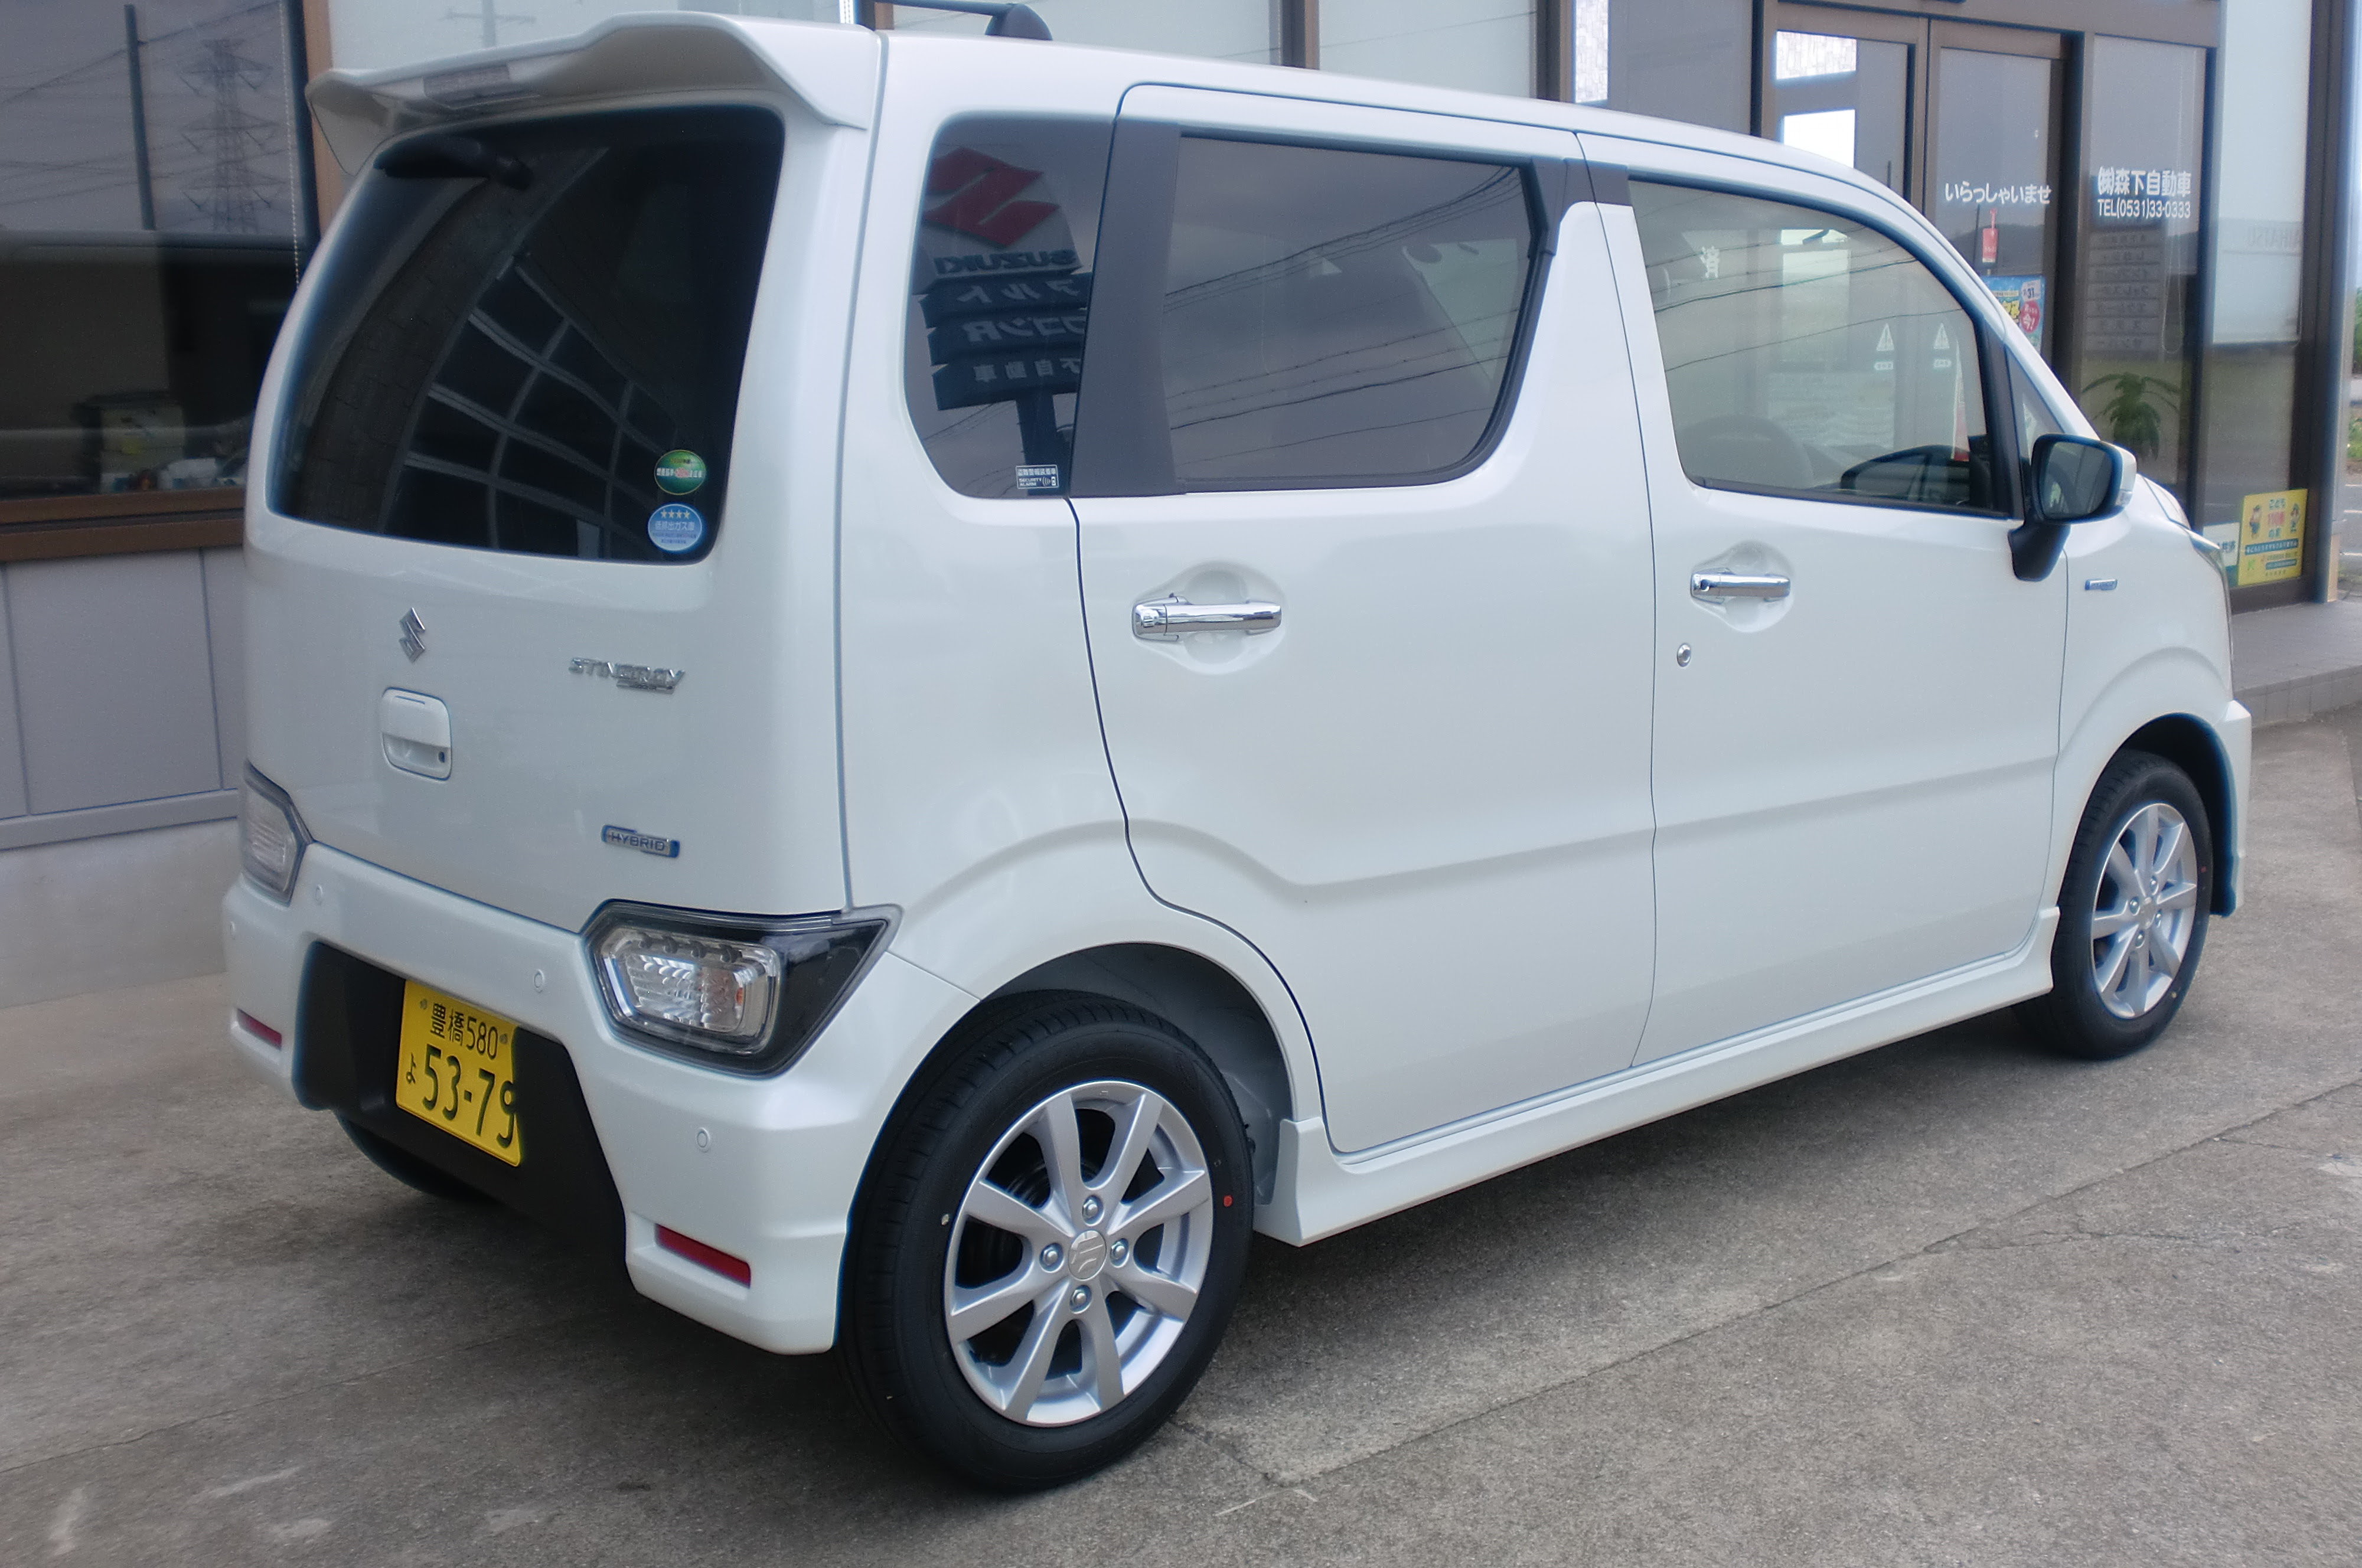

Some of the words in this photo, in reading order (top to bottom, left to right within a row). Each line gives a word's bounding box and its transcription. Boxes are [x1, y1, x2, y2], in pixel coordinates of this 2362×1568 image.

[1945, 180, 2052, 205] いらっしゃいませ
[2097, 198, 2191, 219] TEL(0531)33-0333
[568, 656, 686, 690] STINGRAY
[609, 831, 667, 852] HYBRID
[405, 1051, 417, 1085] よ
